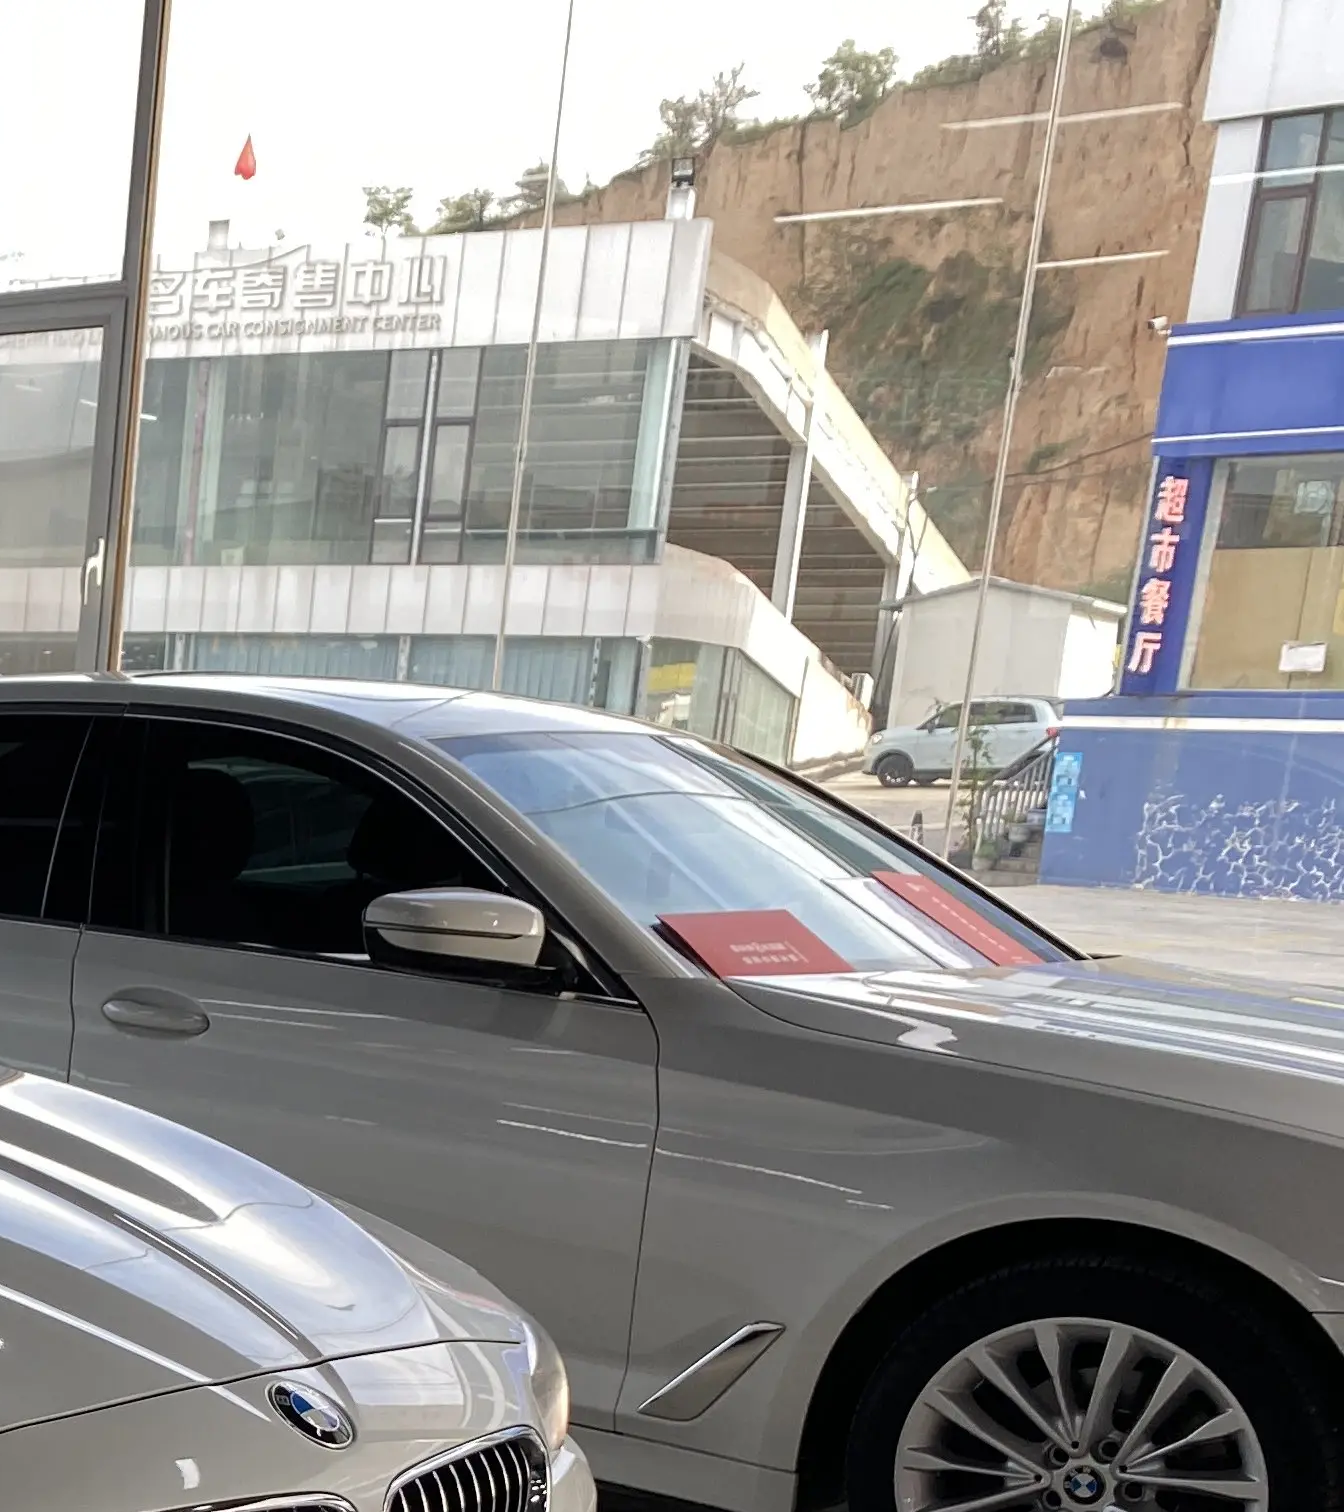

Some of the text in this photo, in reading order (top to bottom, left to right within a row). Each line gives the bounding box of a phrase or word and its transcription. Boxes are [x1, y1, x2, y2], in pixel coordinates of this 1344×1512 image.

[207, 320, 241, 339] CAR
[243, 315, 369, 338] CONSIGNMENT
[373, 312, 442, 332] CENTER
[1127, 475, 1190, 676] 超市餐厅
